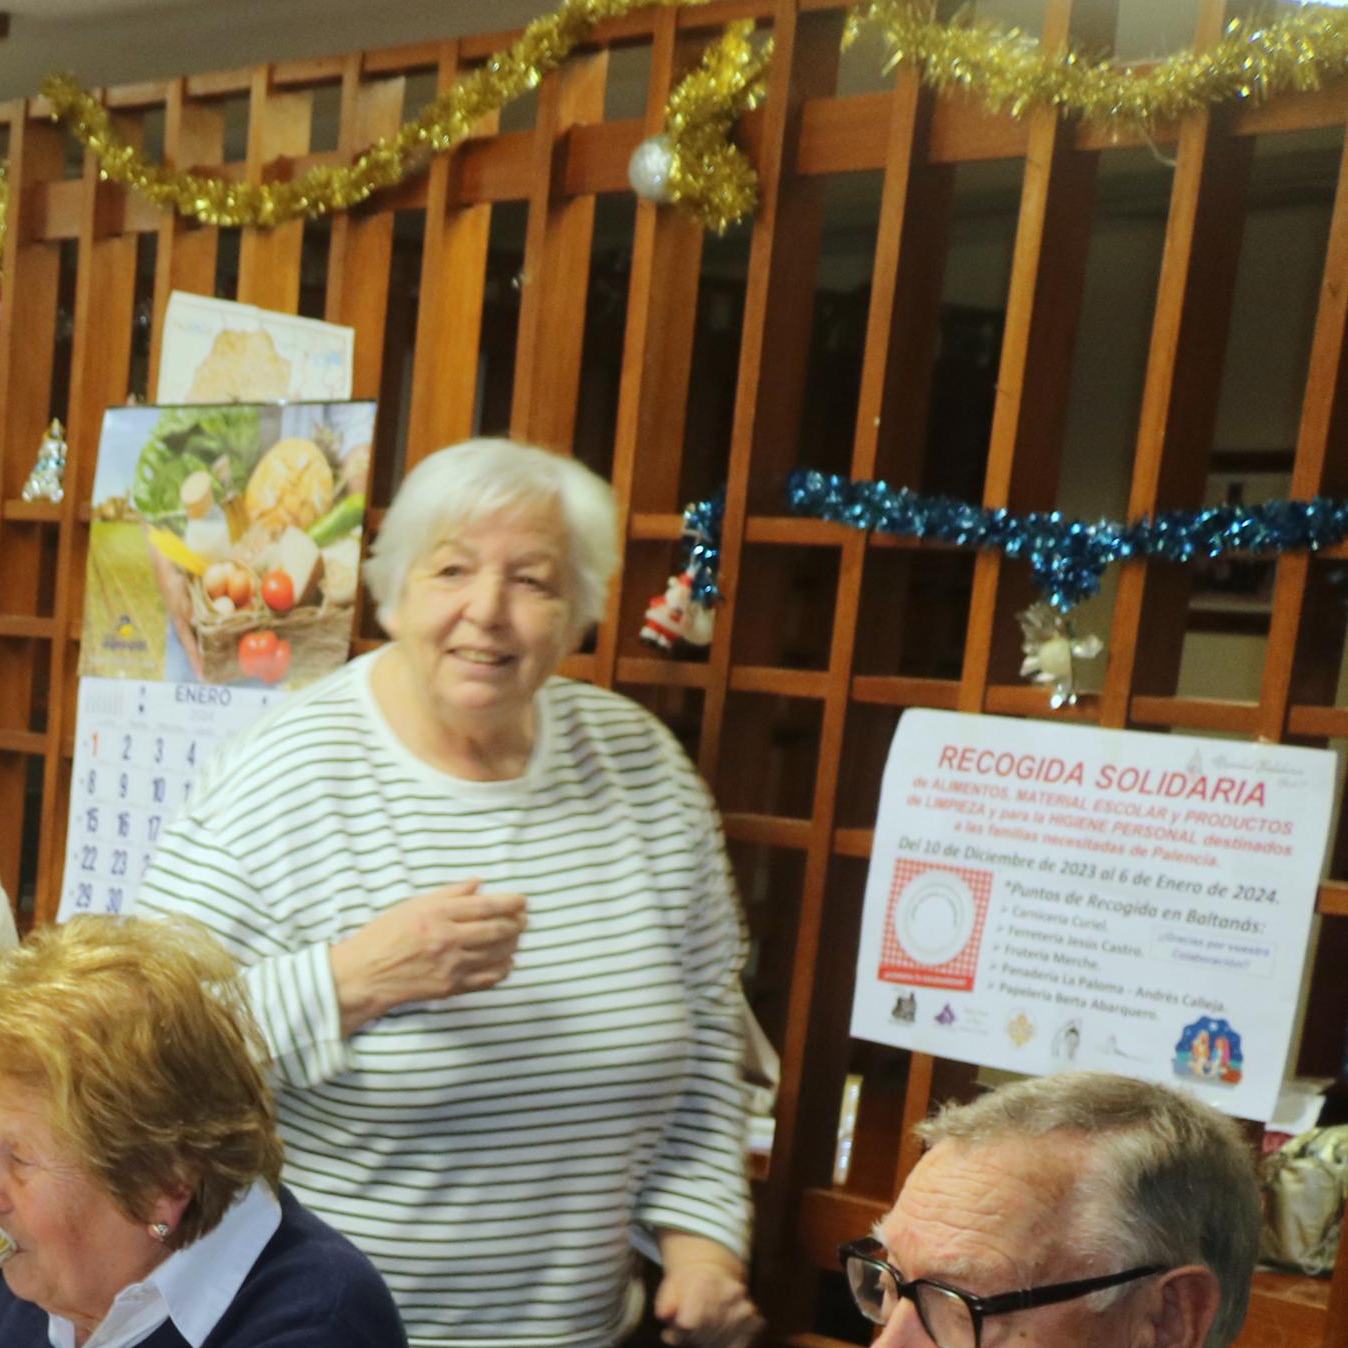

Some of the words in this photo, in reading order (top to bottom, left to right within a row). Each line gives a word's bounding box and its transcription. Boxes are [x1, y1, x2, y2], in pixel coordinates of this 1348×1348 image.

[174, 684, 232, 706] ENERO
[91, 733, 99, 756] 1
[122, 734, 132, 760] 2
[154, 737, 164, 764] 3
[186, 740, 196, 766] 4
[87, 769, 97, 795] 8
[119, 773, 129, 798] 9
[152, 777, 166, 803] 10
[938, 744, 1085, 786] RECOGIDA
[1096, 764, 1266, 807] SOLIDARIA
[912, 776, 927, 788] de
[1016, 789, 1087, 811] MATERIAL
[1093, 799, 1168, 820] ESCOLAR
[1171, 812, 1180, 824] y
[1184, 810, 1294, 836] PRODUCTOS
[86, 808, 100, 833] 15
[117, 812, 130, 837] 16
[148, 815, 161, 841] 17
[907, 794, 921, 807] de
[925, 796, 985, 816] LIMPIEZA
[988, 807, 997, 819] y
[999, 808, 1029, 824] para
[1033, 810, 1044, 824] la
[1048, 813, 1107, 833] HIGIENE
[1111, 822, 1197, 845] PERSONAL
[1203, 833, 1293, 857] destinados
[81, 845, 98, 871] 22
[110, 850, 127, 875] 23
[965, 820, 984, 835] las
[988, 823, 1038, 843] familias
[1042, 834, 1125, 855] necesitadas
[1129, 843, 1147, 856] de
[1151, 847, 1219, 868] Palencia.
[898, 836, 920, 851] Del
[925, 839, 941, 855] 10
[944, 841, 961, 857] de
[964, 845, 1035, 869] Diciembre
[1039, 856, 1057, 872] de
[1060, 860, 1096, 878] 2023
[1100, 866, 1118, 881] al
[1119, 868, 1128, 883] 6
[1132, 869, 1152, 887] de
[1156, 875, 1203, 894] Enero
[1207, 881, 1229, 898] de
[1232, 885, 1280, 906] 2024.
[75, 883, 93, 908] 29
[106, 888, 123, 913] 30
[1065, 890, 1083, 905] de
[1087, 895, 1158, 918] Recogida
[1162, 908, 1182, 921] en
[1063, 973, 1076, 986] La
[1078, 976, 1125, 995] Paloma
[1056, 993, 1087, 1009] Berta
[1090, 999, 1161, 1021] Abarquero.
